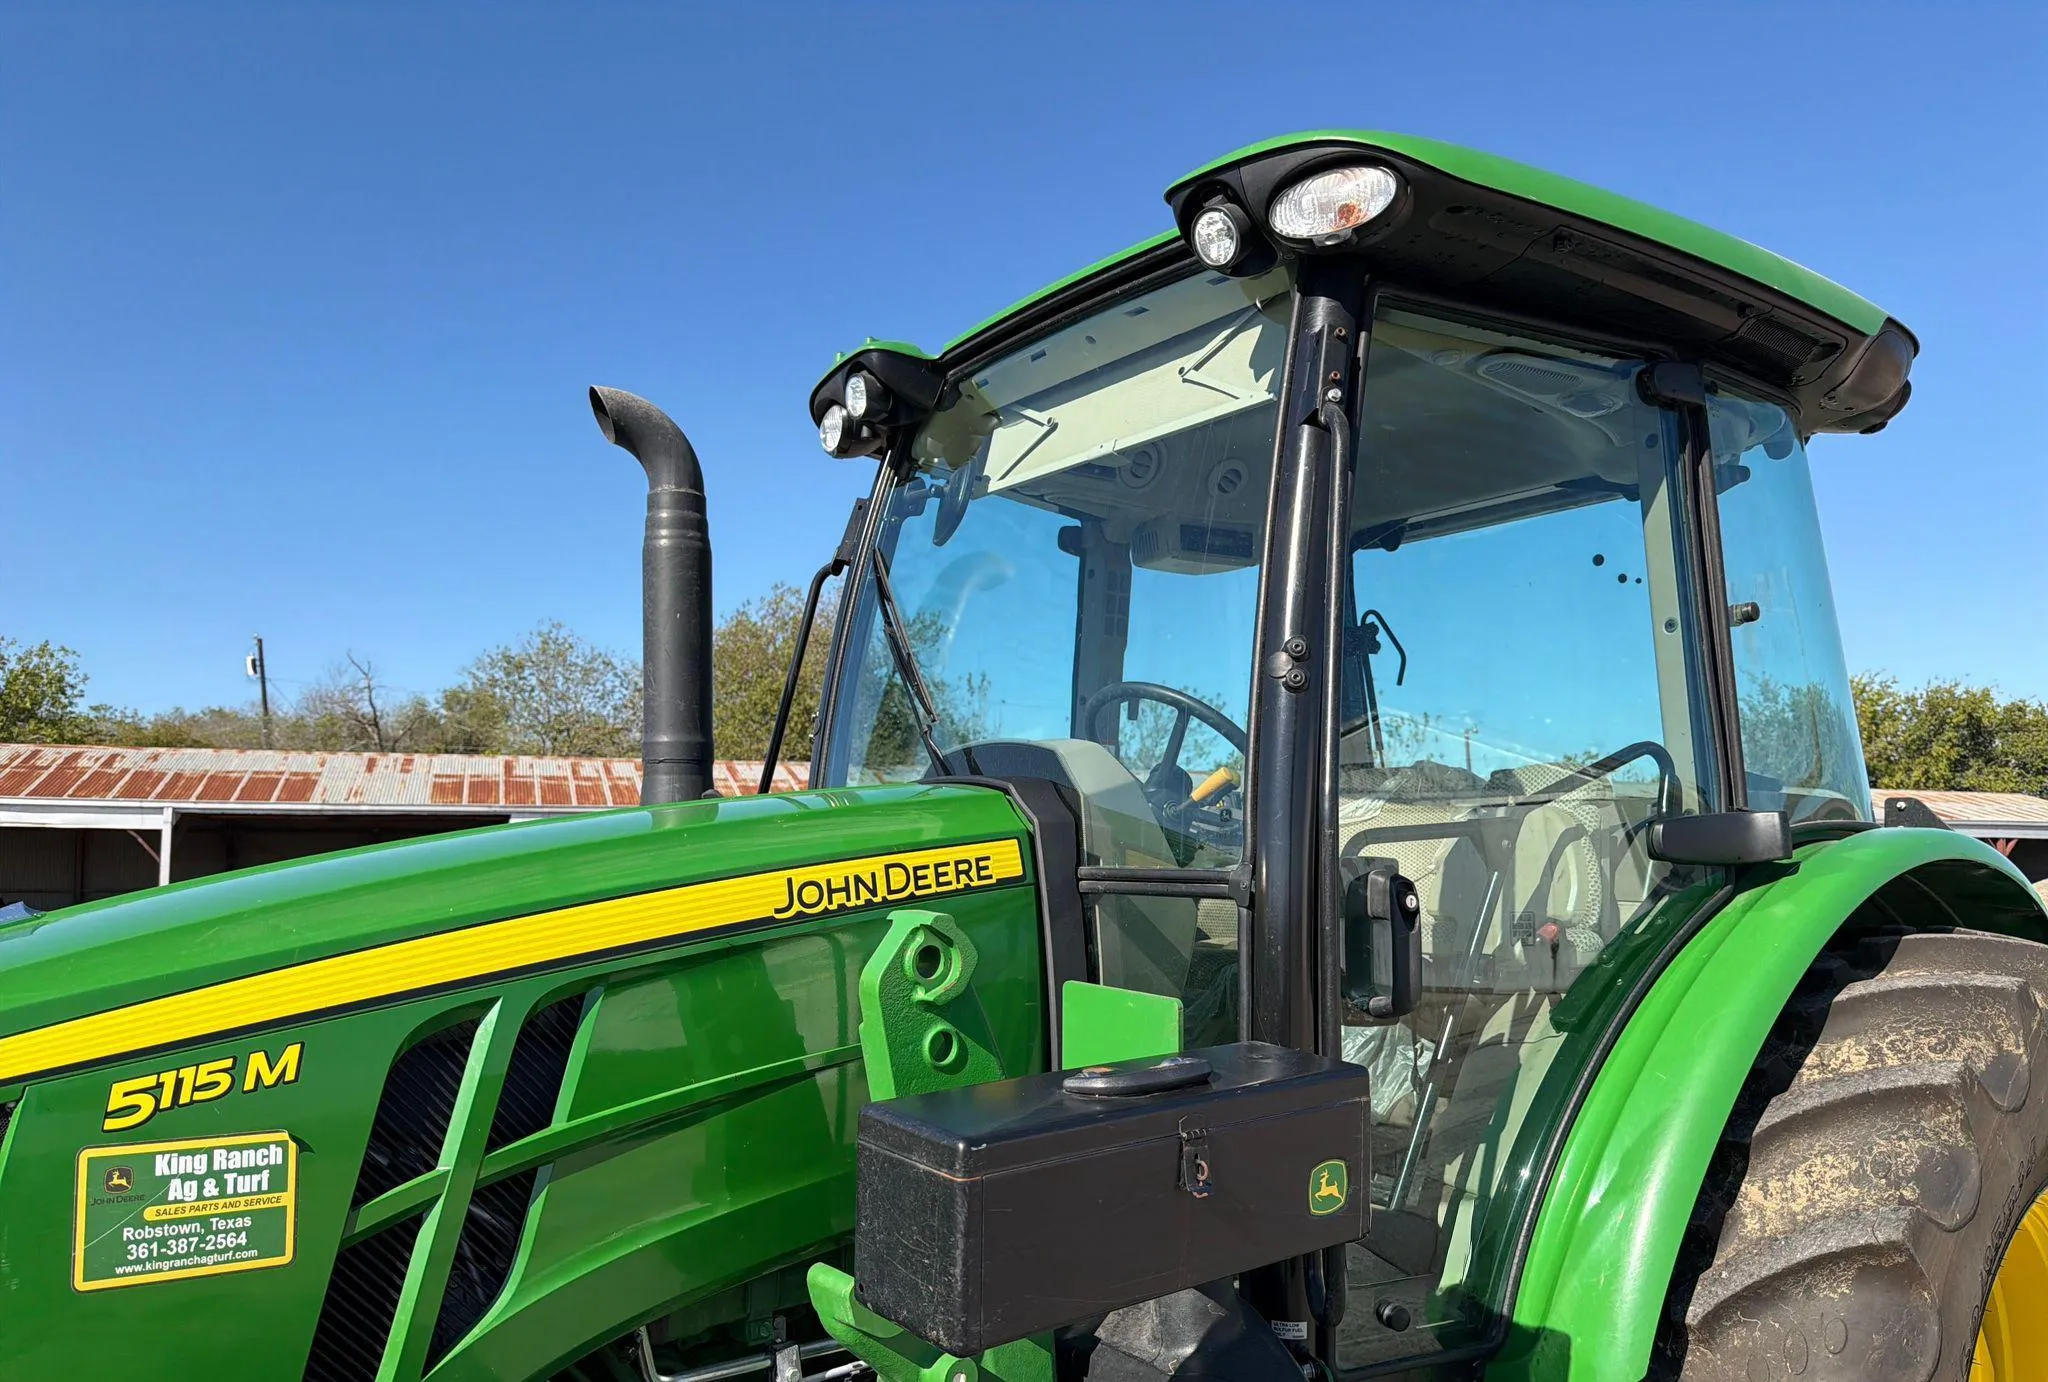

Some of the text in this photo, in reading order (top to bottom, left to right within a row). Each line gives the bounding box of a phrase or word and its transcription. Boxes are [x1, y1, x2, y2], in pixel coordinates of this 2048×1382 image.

[773, 855, 992, 915] JOHN DEERE
[102, 1042, 304, 1132] 5115 M
[155, 1144, 283, 1177] King Ranch
[91, 1194, 145, 1206] JOHN DEERE
[167, 1170, 270, 1202] Ag & Turf
[154, 1195, 282, 1217] SALES PARTS AND SERVICE
[123, 1216, 252, 1241] Robstown, Texas
[126, 1231, 248, 1260] 361-387-2564
[115, 1248, 258, 1275] www.kingranchagturf.com
